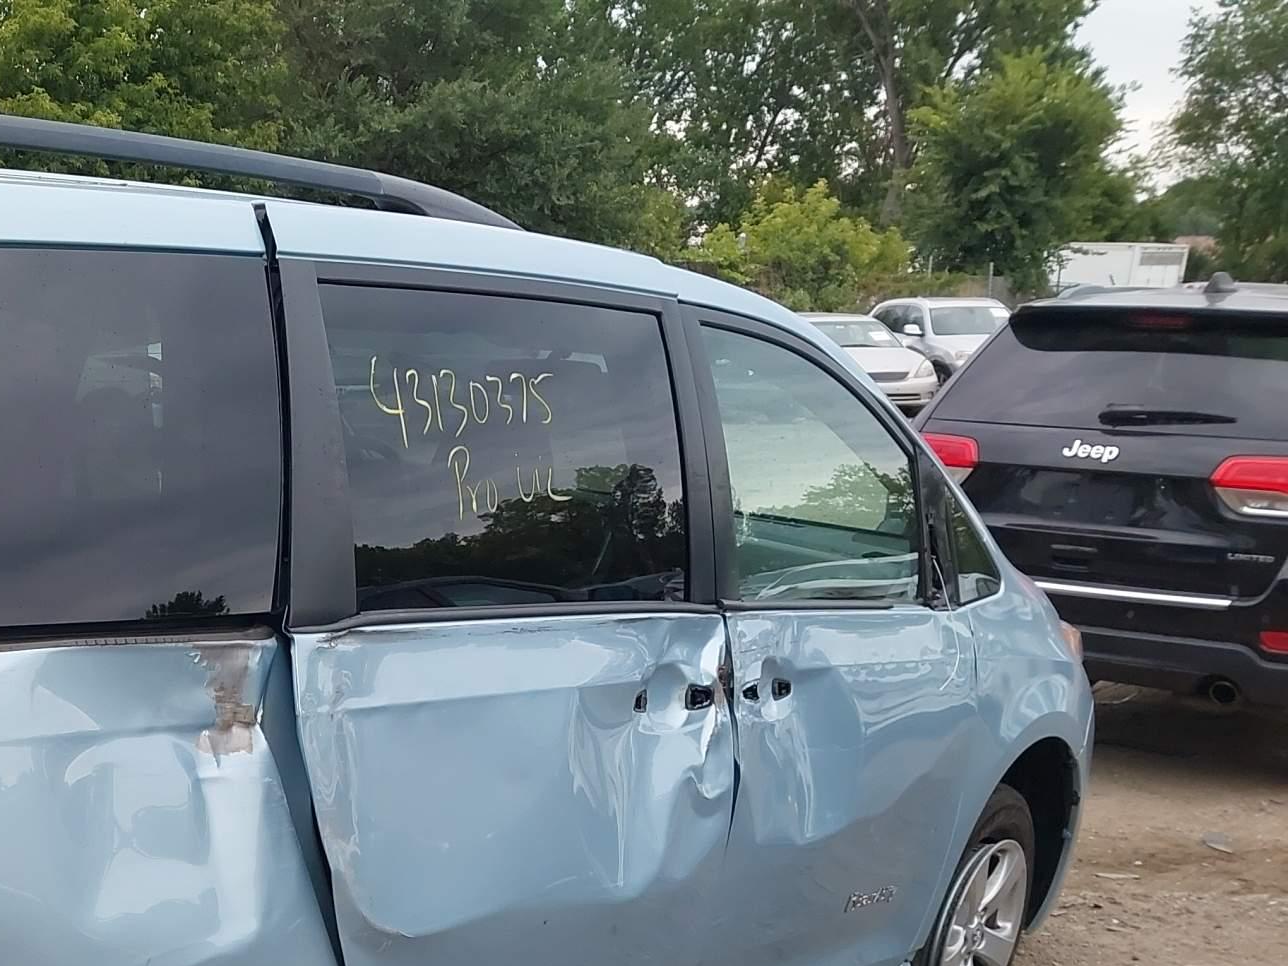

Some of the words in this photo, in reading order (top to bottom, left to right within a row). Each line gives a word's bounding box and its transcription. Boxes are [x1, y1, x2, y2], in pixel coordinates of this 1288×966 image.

[369, 355, 554, 449] 43130375
[447, 445, 498, 521] Pro
[1062, 439, 1120, 463] Jeep
